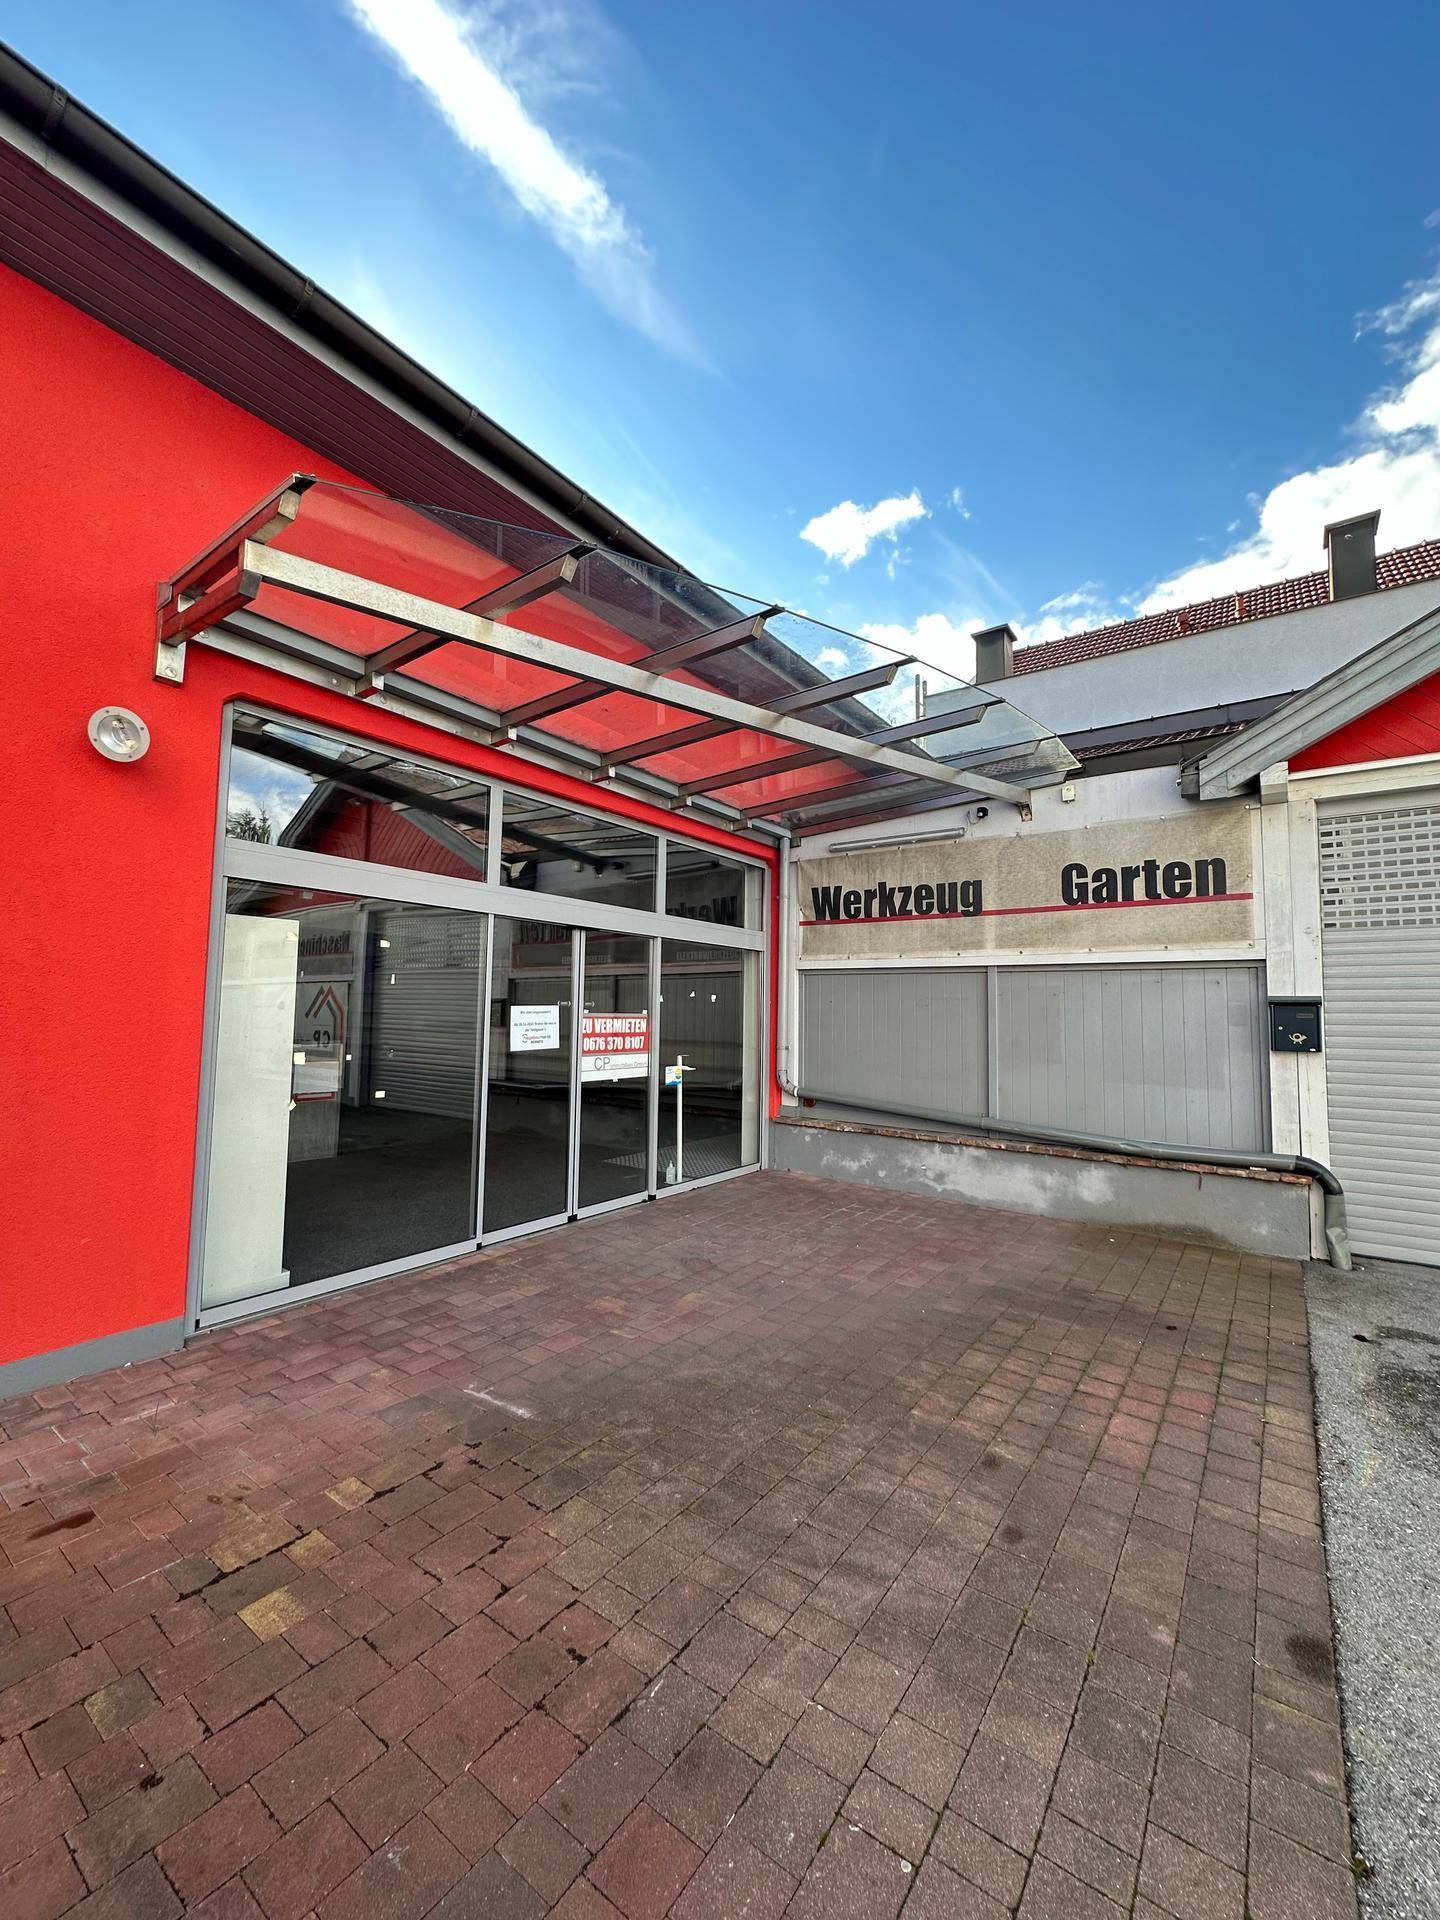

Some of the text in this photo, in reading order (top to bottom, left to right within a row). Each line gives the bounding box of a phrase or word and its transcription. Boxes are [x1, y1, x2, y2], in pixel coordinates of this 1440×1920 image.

[811, 856, 1227, 921] Werkzeug Garten
[582, 1018, 647, 1034] ZU VERMIETEN
[583, 1035, 645, 1051] 0676 370 8107
[594, 1056, 611, 1071] CP
